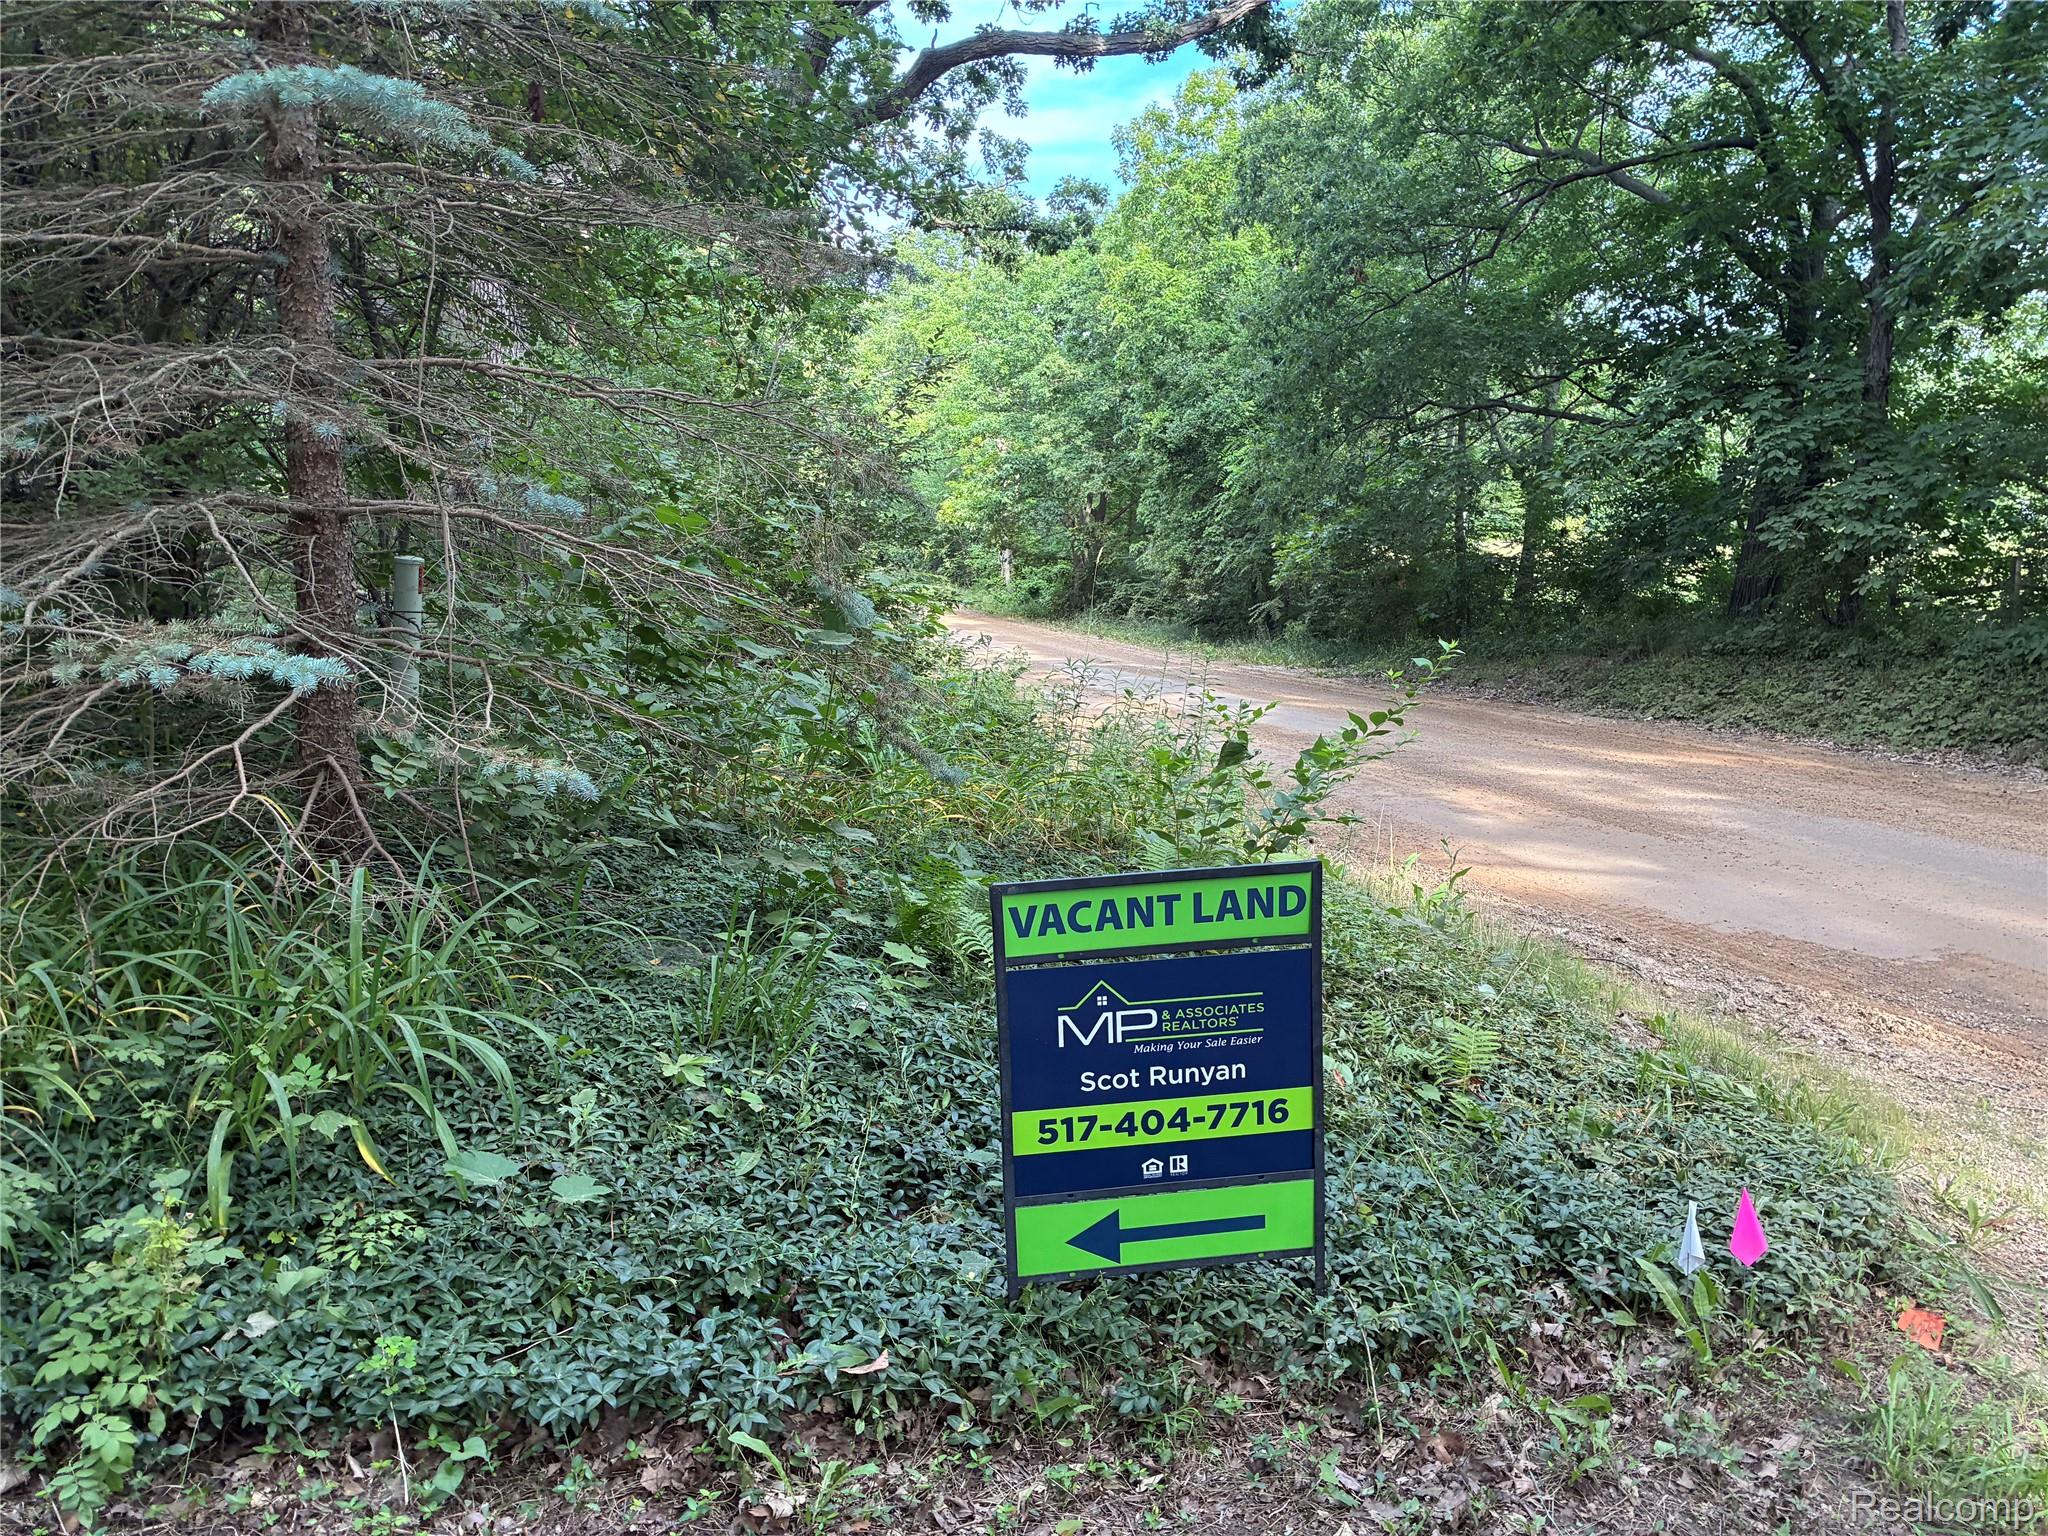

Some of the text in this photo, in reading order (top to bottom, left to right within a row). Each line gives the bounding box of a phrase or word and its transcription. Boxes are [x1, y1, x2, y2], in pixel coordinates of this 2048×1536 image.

[1008, 885, 1307, 938] VACANT LAND
[1057, 1008, 1158, 1048] MP
[1161, 1002, 1265, 1020] & ASSOCIATES
[1133, 1034, 1263, 1054] Making Your Sale Easier
[1080, 1063, 1246, 1092] Scot Runyan
[1037, 1098, 1289, 1145] 517-404-7716
